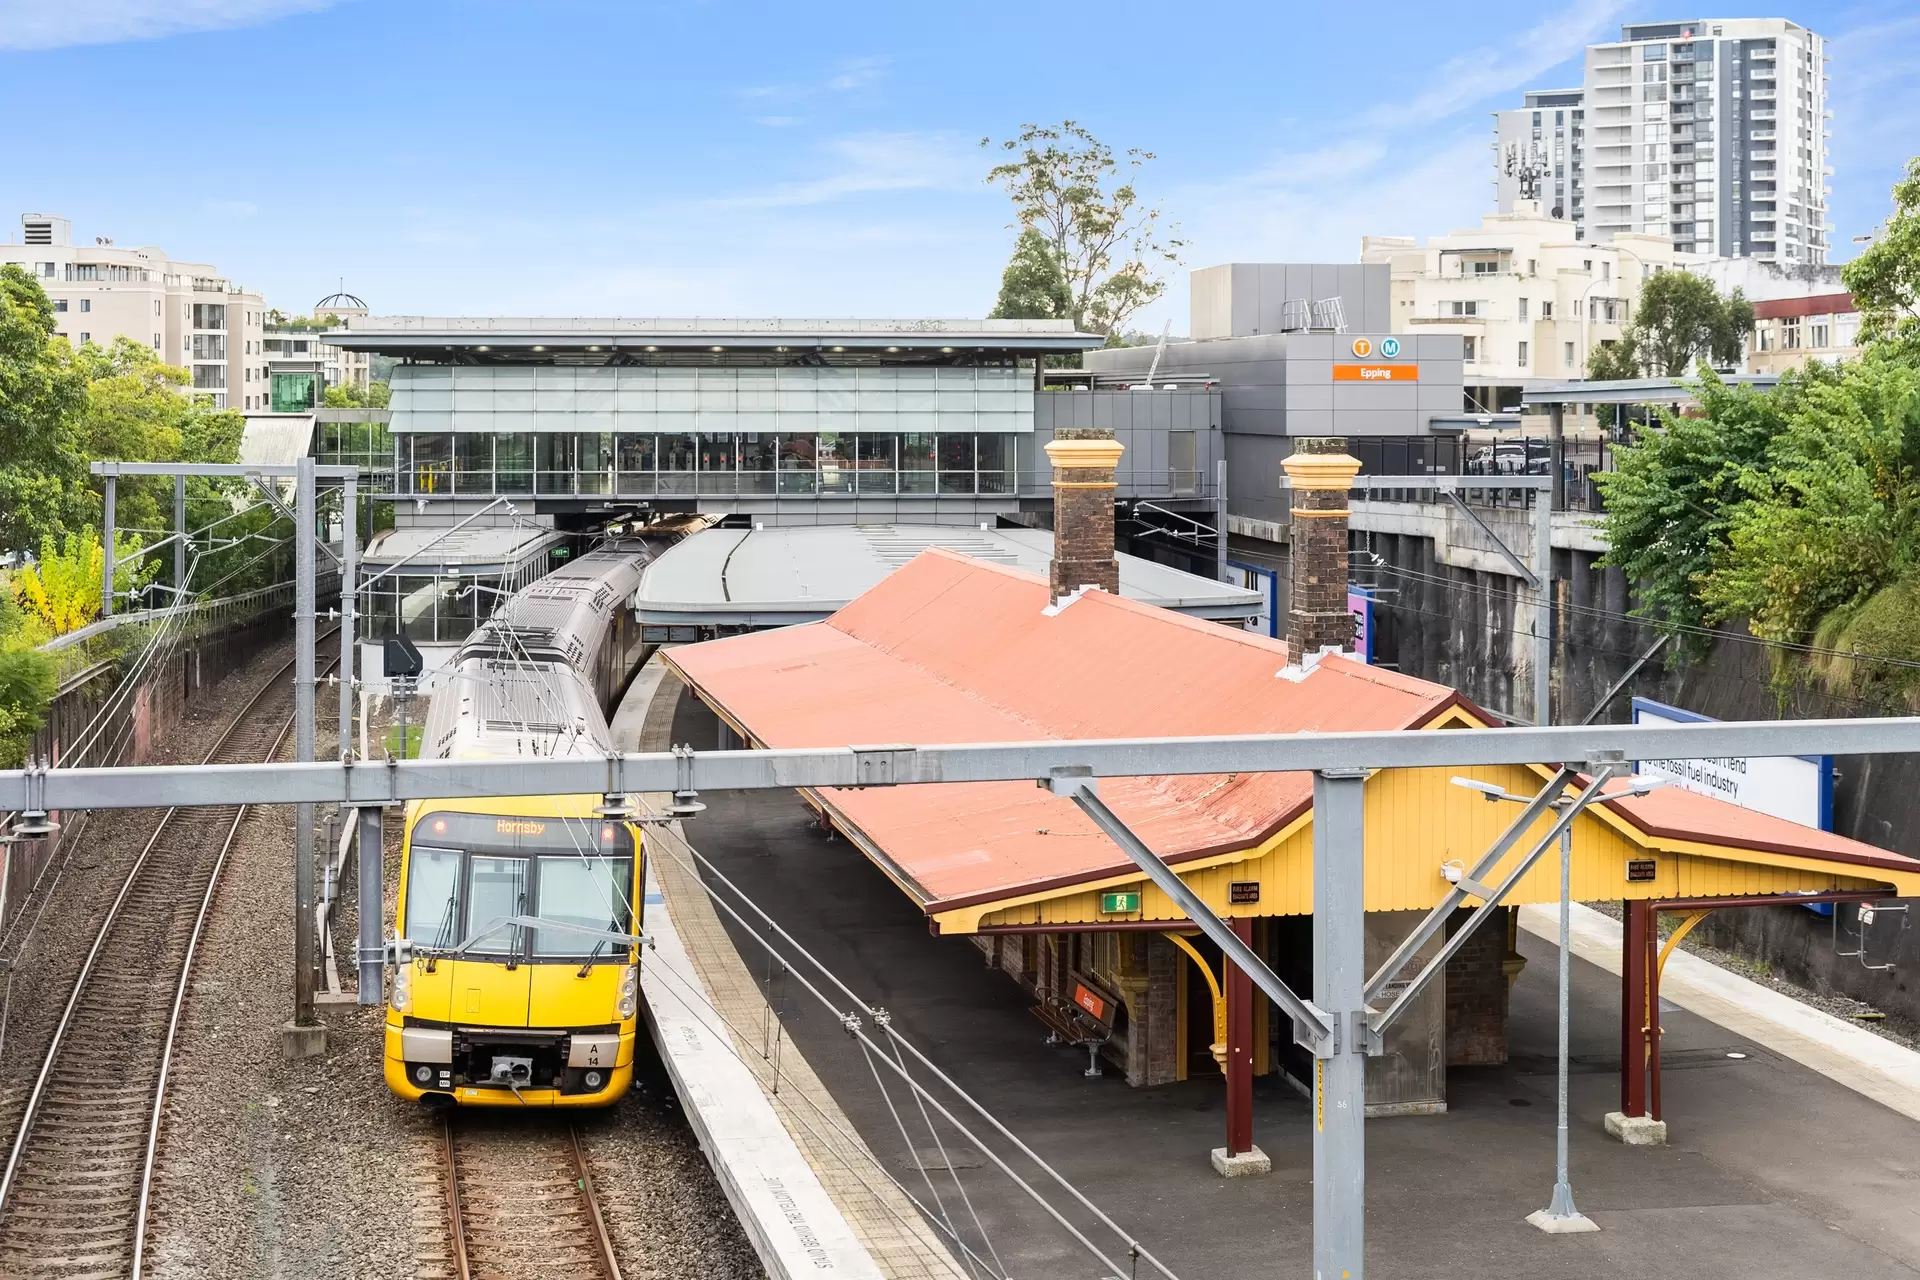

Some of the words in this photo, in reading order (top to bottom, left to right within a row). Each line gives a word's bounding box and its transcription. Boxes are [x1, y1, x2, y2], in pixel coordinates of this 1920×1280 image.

[1360, 367, 1391, 380] Epping
[1688, 761, 1703, 783] fuel
[1704, 767, 1739, 799] industry
[497, 819, 545, 836] Hornsby
[590, 1044, 599, 1054] A
[587, 1057, 599, 1066] 14
